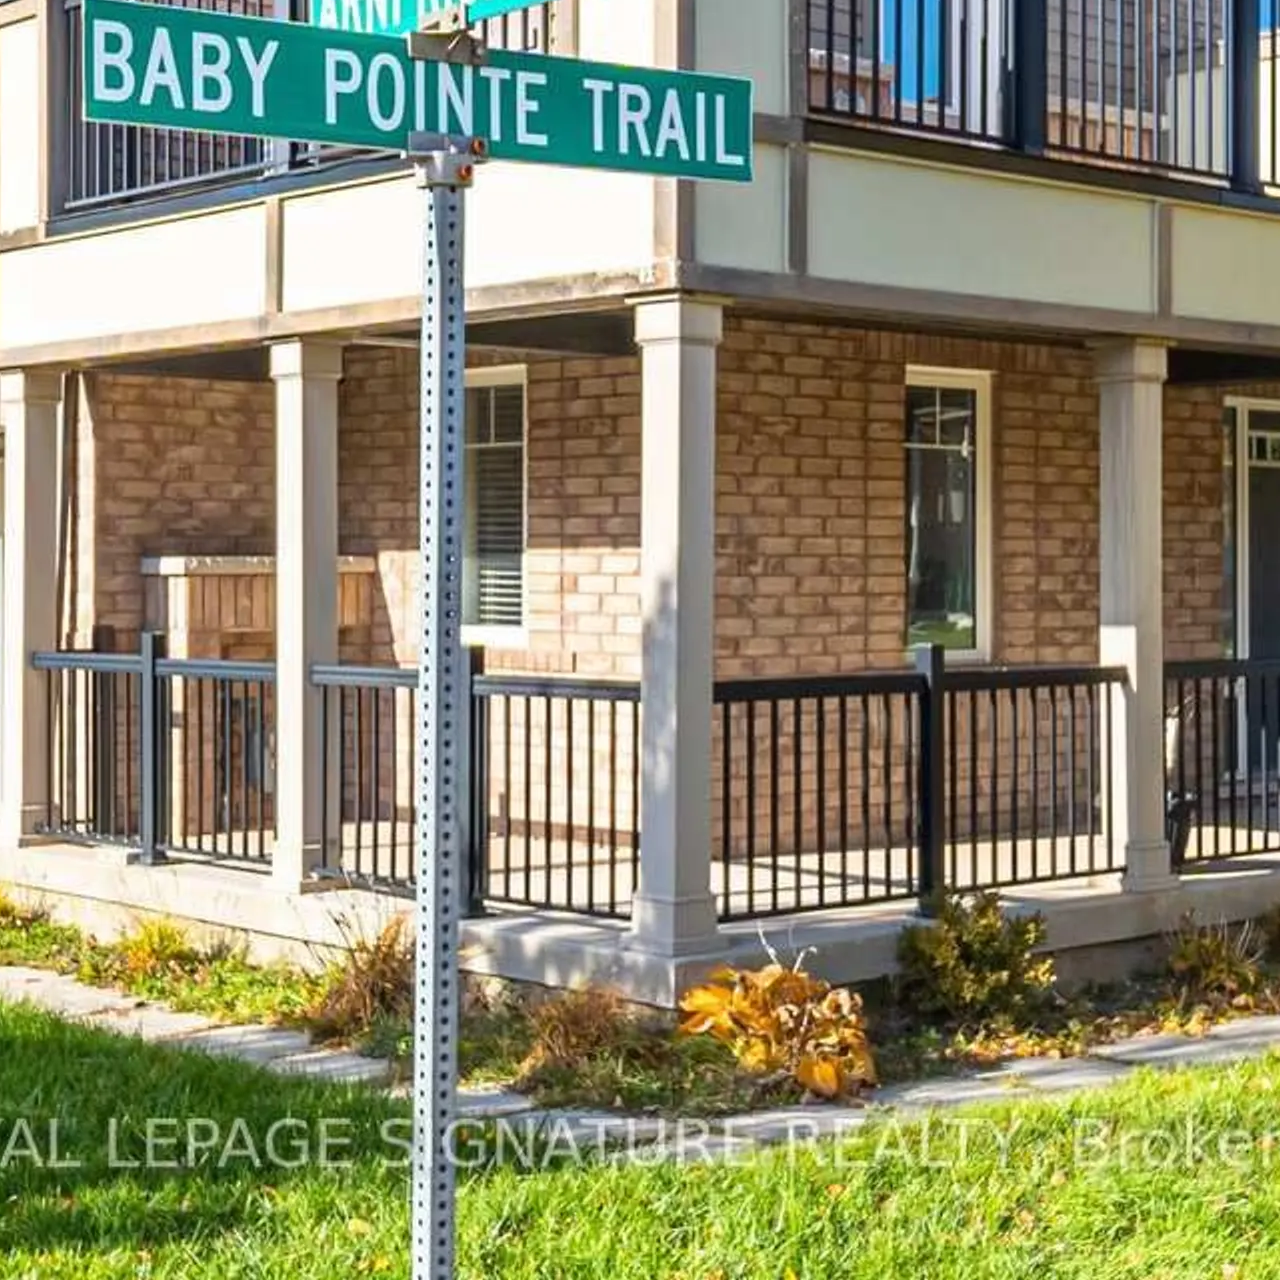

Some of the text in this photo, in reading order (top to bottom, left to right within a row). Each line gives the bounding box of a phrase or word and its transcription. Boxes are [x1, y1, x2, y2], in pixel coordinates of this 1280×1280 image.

[93, 20, 744, 166] BABY POINTE TRAIL
